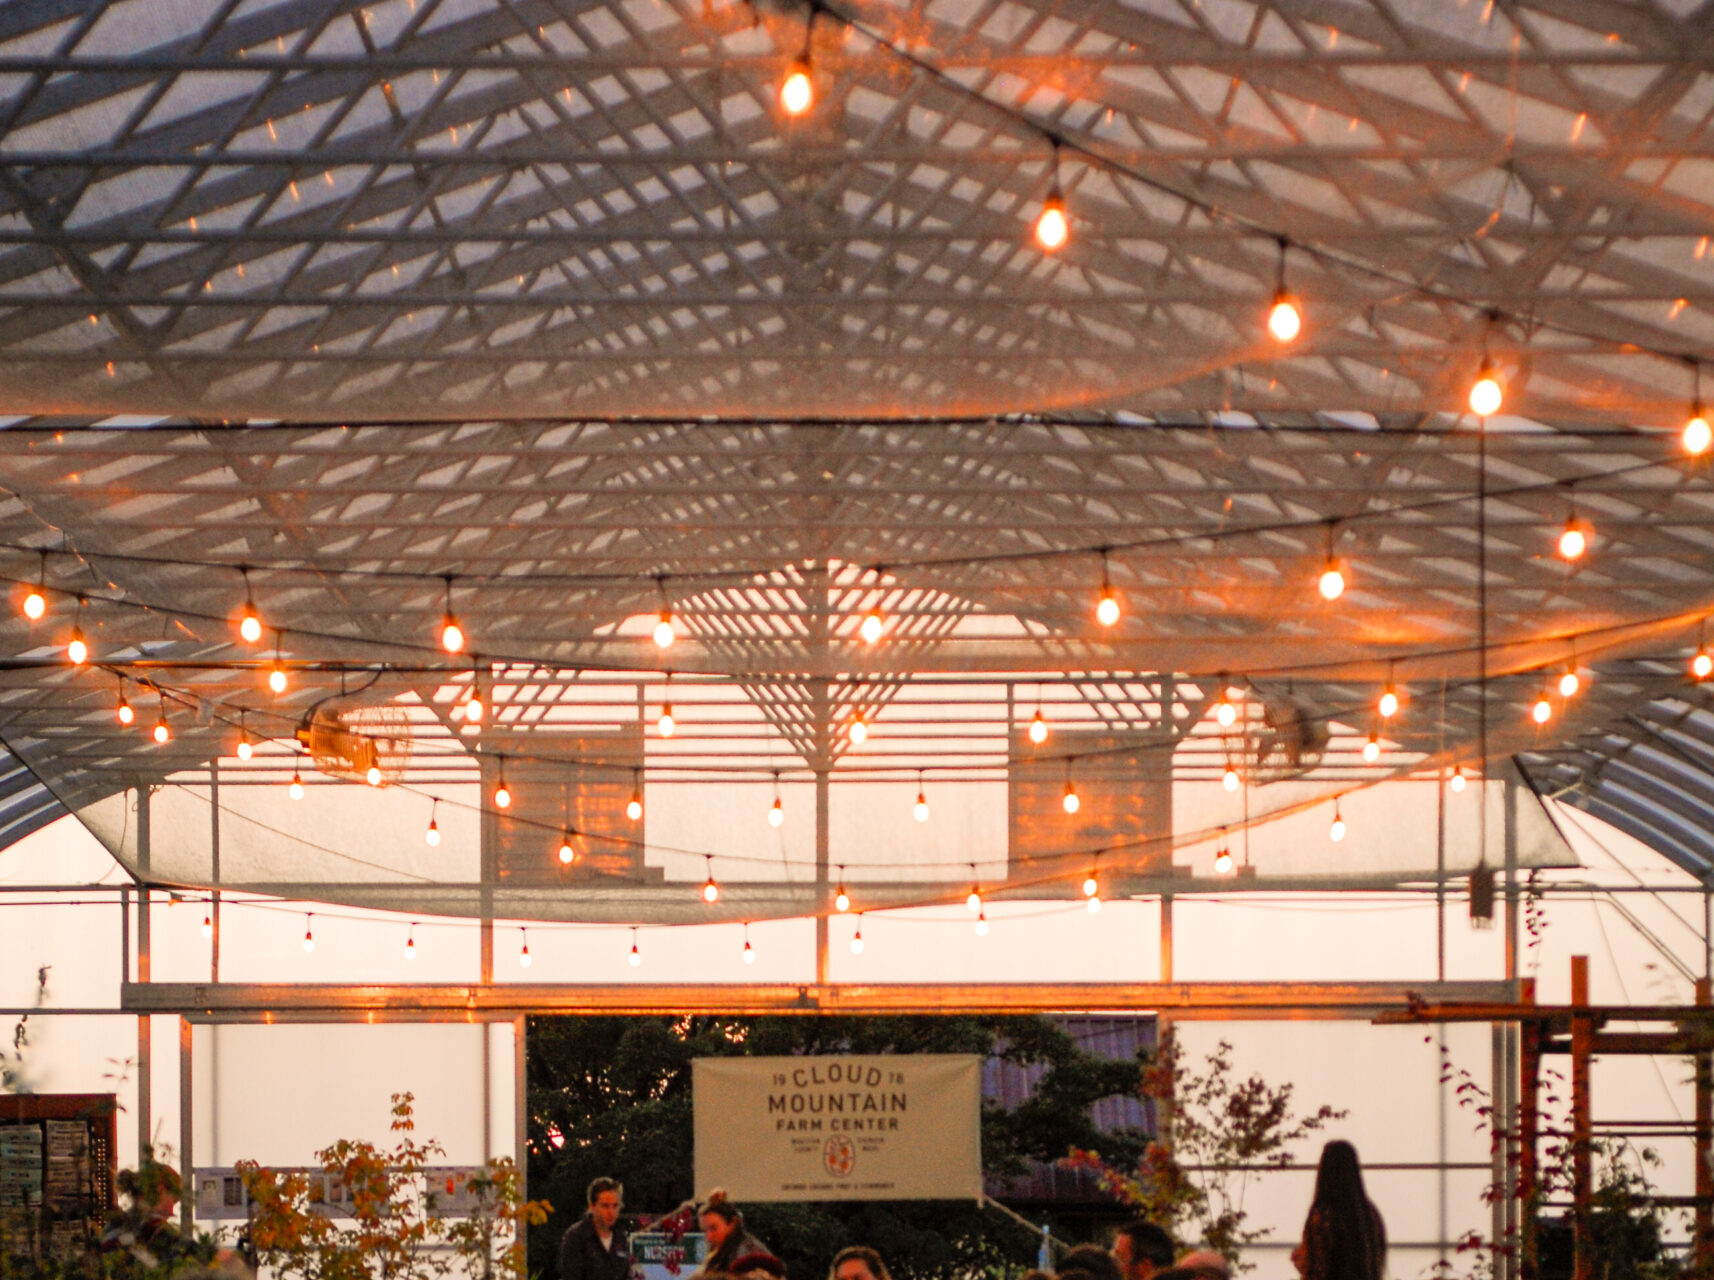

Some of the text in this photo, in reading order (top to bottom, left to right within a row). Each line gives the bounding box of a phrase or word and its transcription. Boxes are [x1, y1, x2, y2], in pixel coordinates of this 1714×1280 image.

[773, 1072, 786, 1086] 19
[792, 1063, 882, 1088] CLOUD
[768, 1092, 907, 1113] MOUNTAIN
[776, 1117, 899, 1131] FARM CENTER
